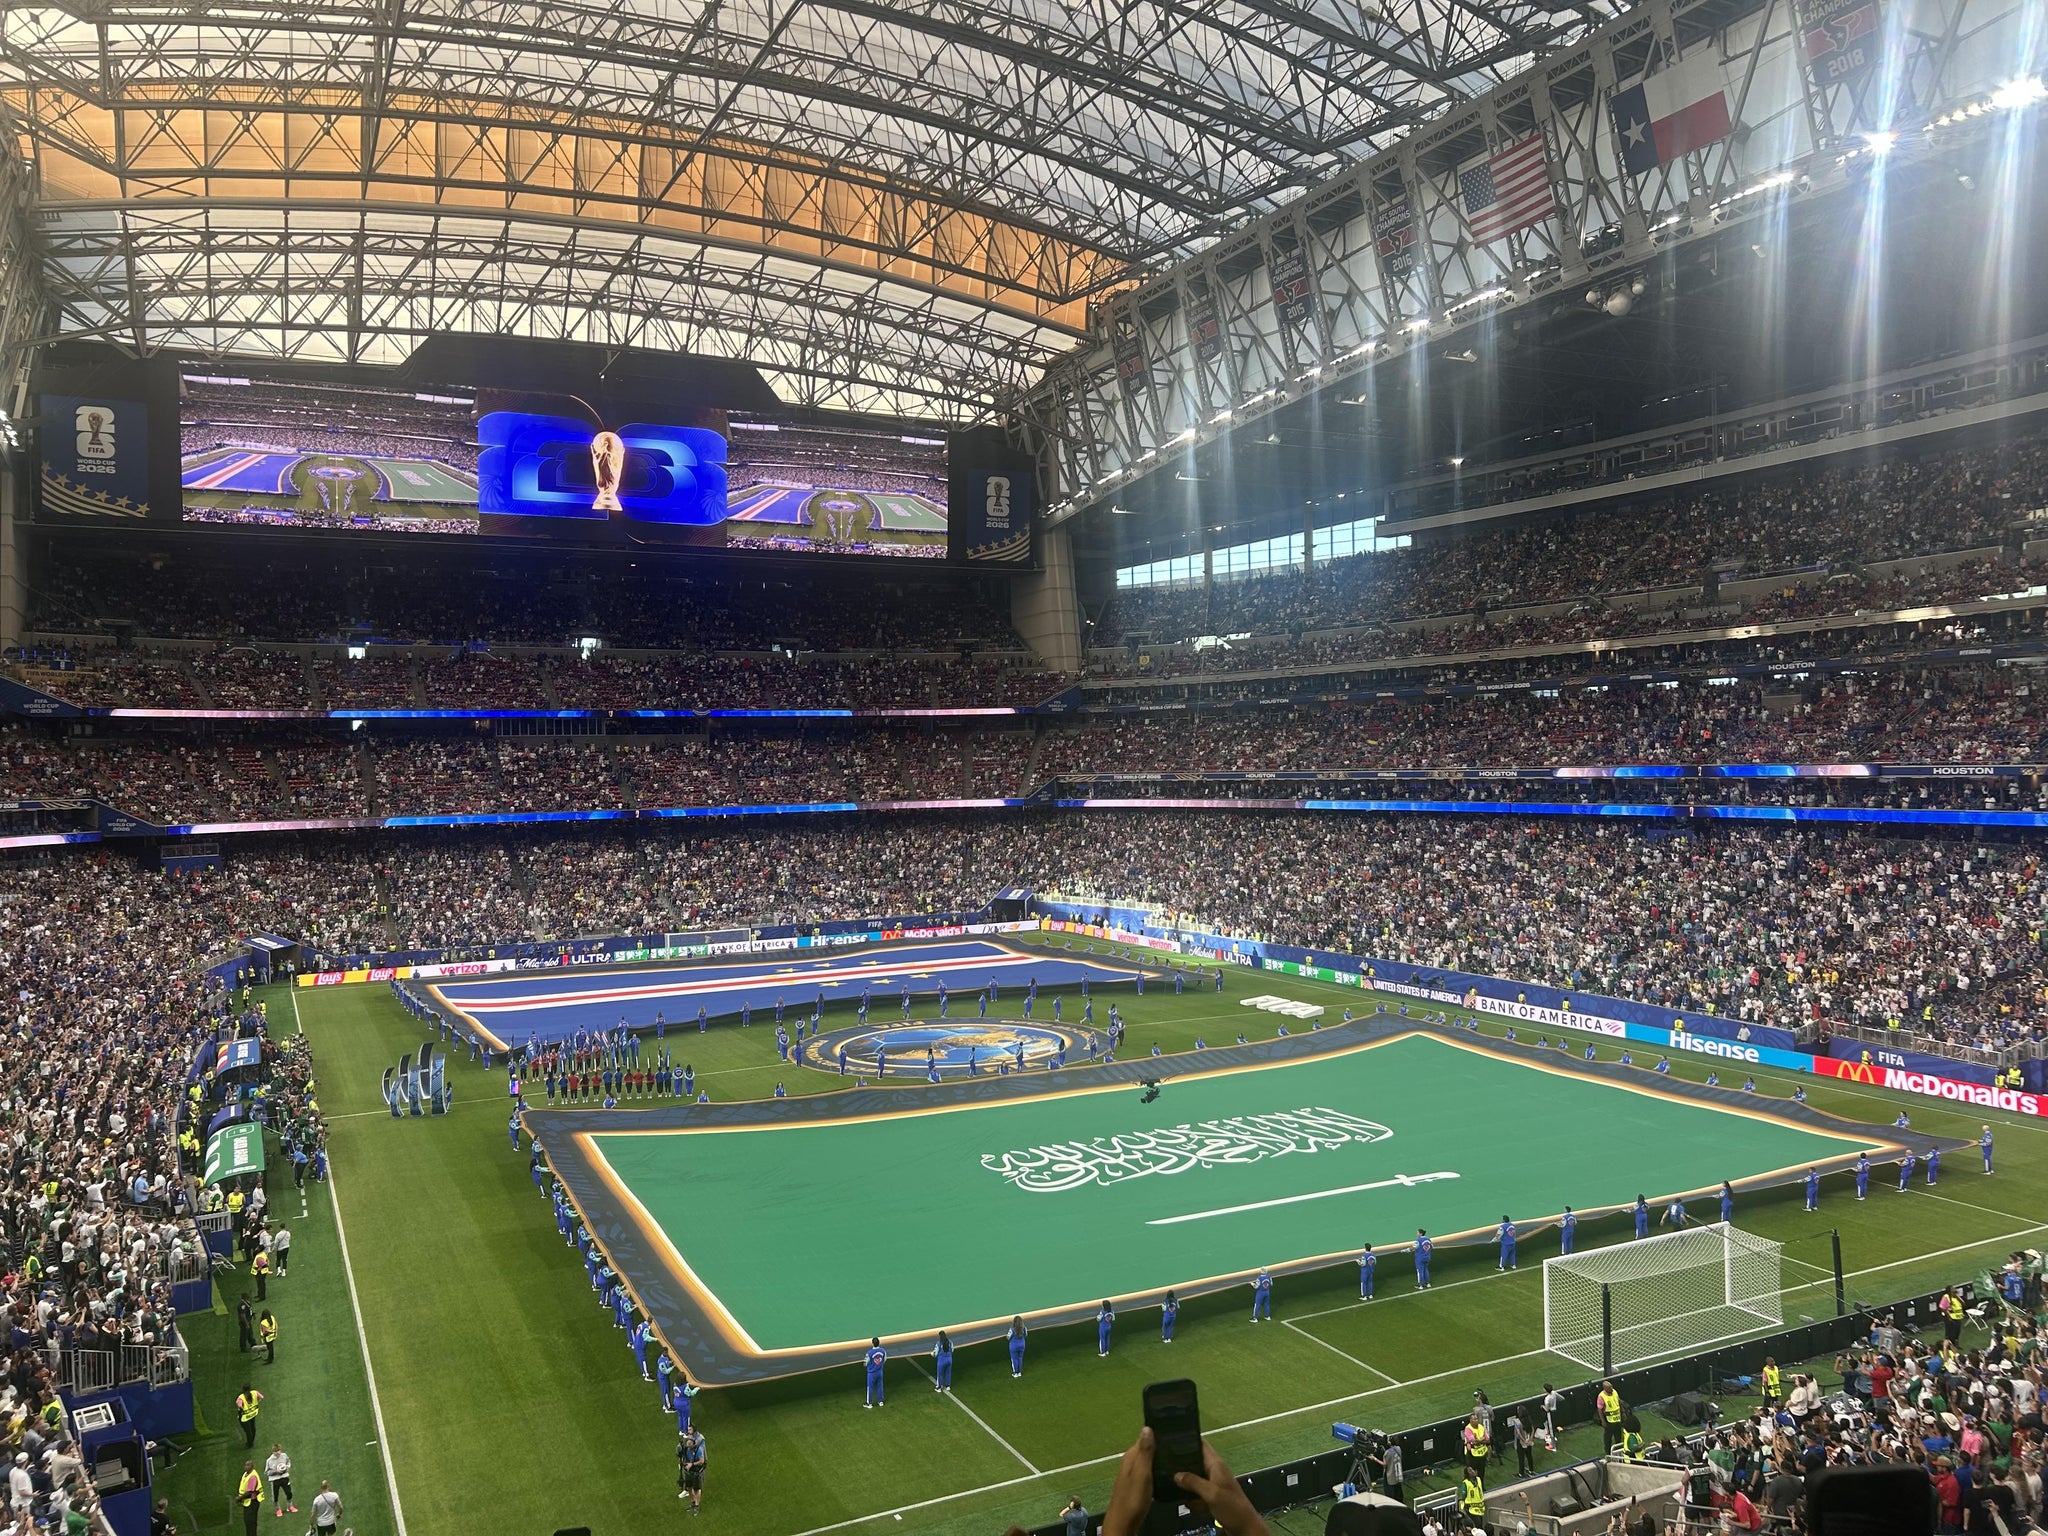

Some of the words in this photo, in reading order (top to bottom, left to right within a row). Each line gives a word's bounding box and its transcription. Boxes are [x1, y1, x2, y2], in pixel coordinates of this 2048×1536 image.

[1828, 48, 1865, 77] 2018
[1377, 210, 1411, 232] CHAMPIONS
[1392, 254, 1412, 271] 2016
[1273, 264, 1303, 283] CHAMPIONS
[1286, 303, 1305, 319] 2015
[77, 464, 116, 474] 2026
[1768, 661, 1816, 671] HOUSTON
[1933, 767, 1994, 775] HOUSTON
[810, 934, 869, 946] Hiense
[1117, 934, 1139, 944] verizon
[1148, 939, 1172, 950] verizon
[571, 953, 611, 964] ULTRA
[1188, 944, 1217, 960] Michelob
[1223, 951, 1252, 967] ULTRA
[318, 972, 343, 985] Lay's
[1373, 980, 1396, 993] UNITED
[1396, 984, 1420, 997] STATES
[1420, 987, 1431, 998] OF
[1430, 989, 1462, 1005] AMERICA
[1481, 998, 1515, 1015] BANK
[1519, 1006, 1536, 1018] OF
[1539, 1009, 1603, 1032] AMERICA
[1669, 1030, 1760, 1063] Hisense
[1878, 1051, 1905, 1068] FIFA
[1884, 1068, 2039, 1115] McDonald's
